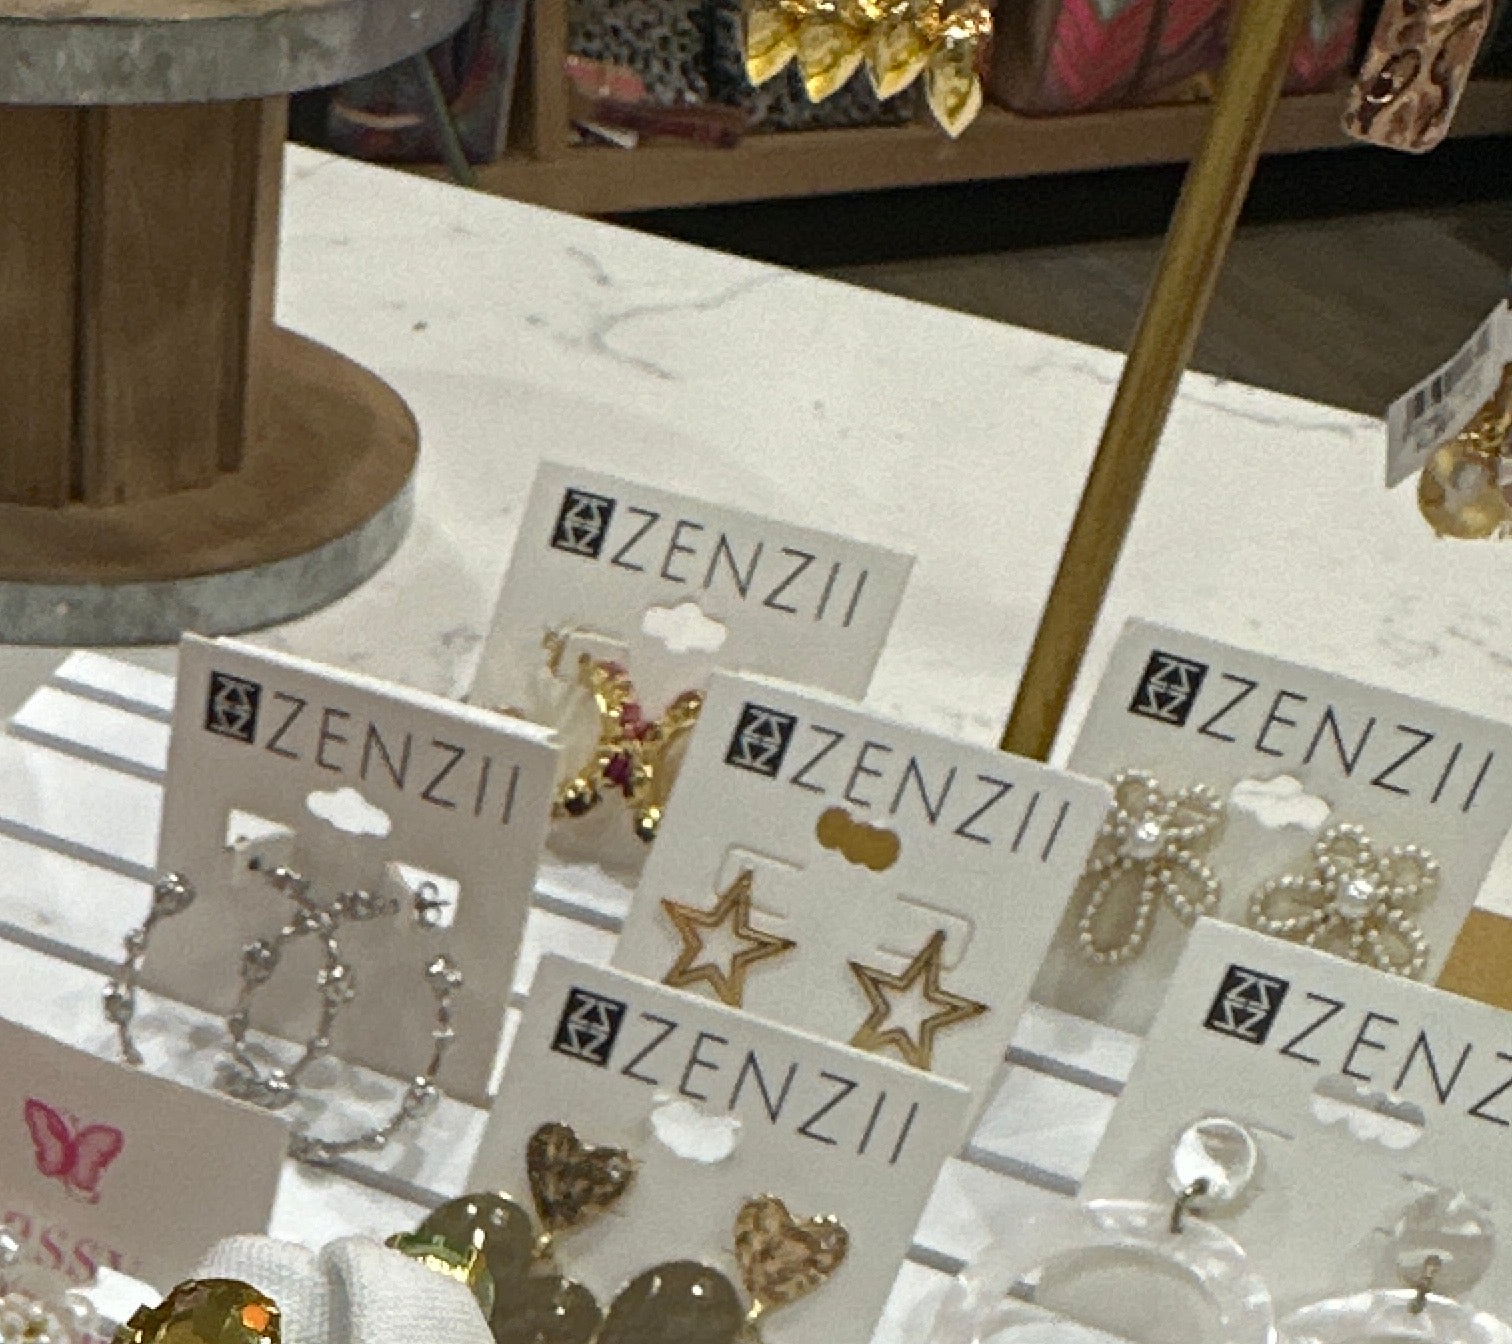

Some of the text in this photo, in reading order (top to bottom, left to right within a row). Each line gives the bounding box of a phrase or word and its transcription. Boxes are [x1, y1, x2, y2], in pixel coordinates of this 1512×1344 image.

[610, 505, 870, 628] ZENZII
[264, 690, 520, 826] ZENZII
[789, 723, 1070, 863] ZENZII
[1197, 671, 1494, 814] ZENZII
[620, 1011, 919, 1165] ZENZII
